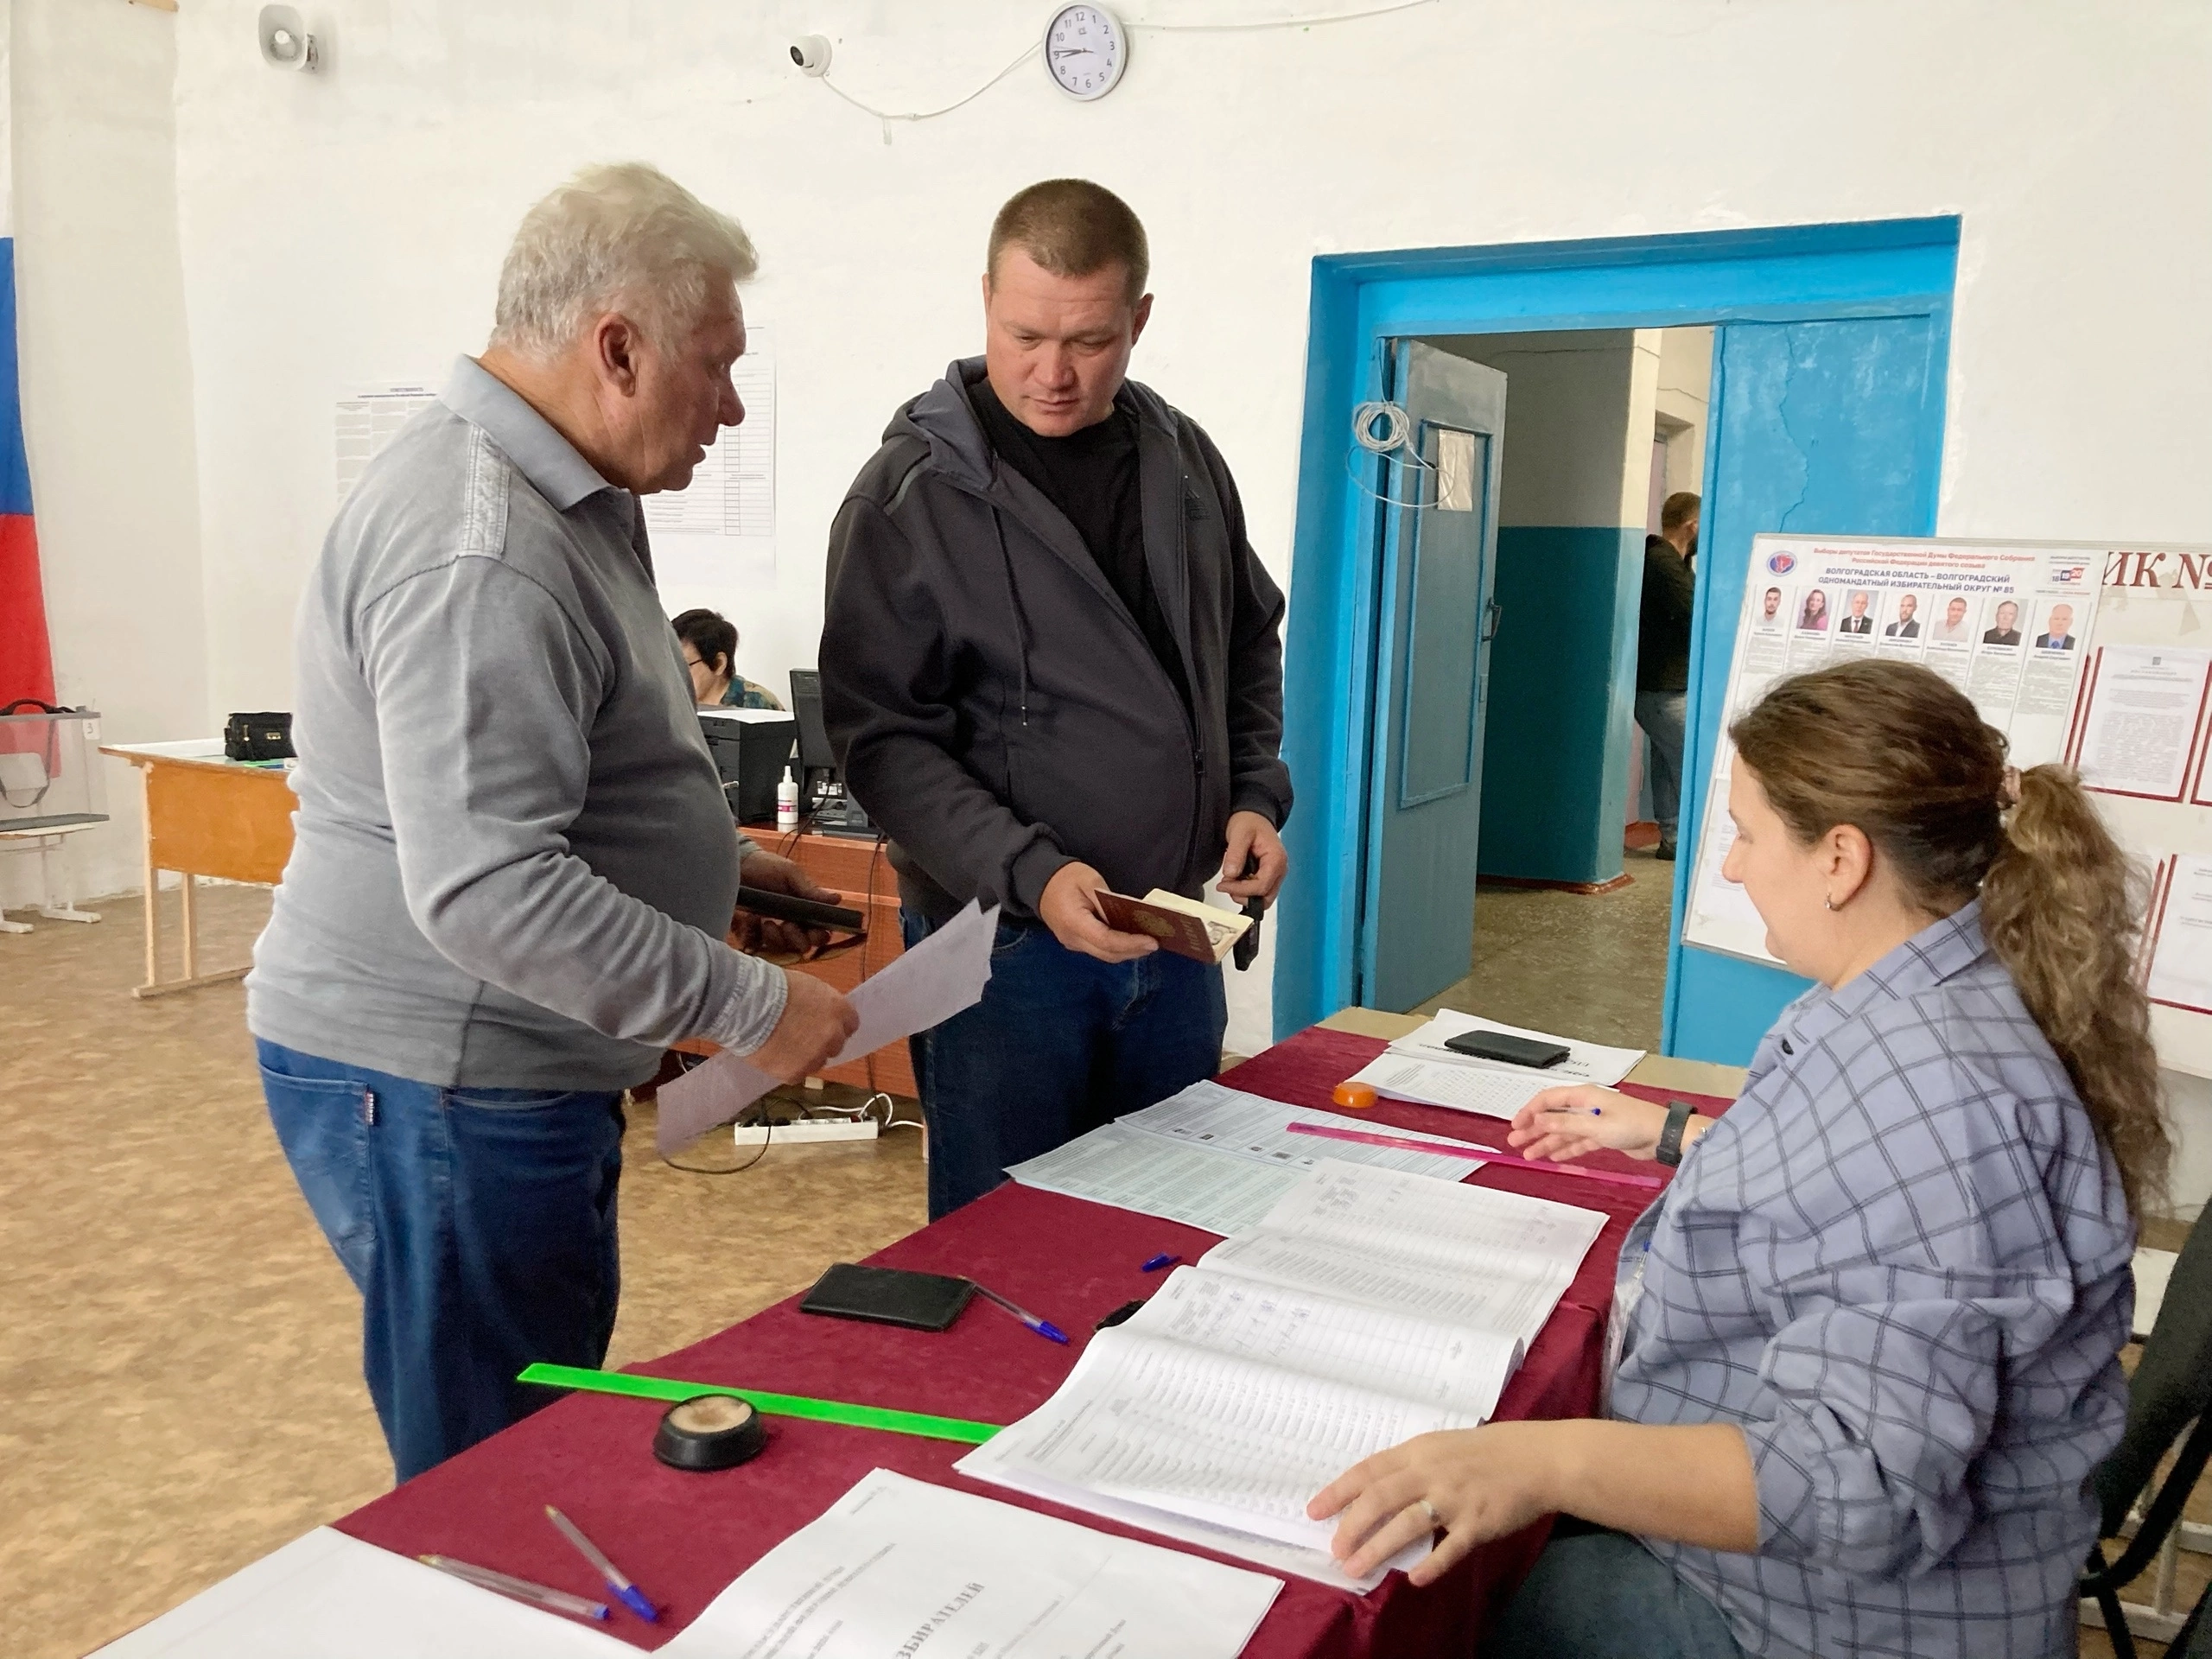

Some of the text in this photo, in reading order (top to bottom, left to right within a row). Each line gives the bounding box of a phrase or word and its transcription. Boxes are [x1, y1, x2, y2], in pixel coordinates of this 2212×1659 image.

[1076, 12, 1085, 22] 12
[1092, 15, 1096, 23] 1
[1065, 19, 1072, 29] 11
[1103, 25, 1109, 35] 2
[1056, 32, 1065, 42] 10
[1109, 41, 1115, 50] 3
[1053, 50, 1059, 60] 9
[1107, 59, 1112, 67] 4
[1060, 66, 1065, 75] 8
[1072, 77, 1077, 86] 7
[1099, 73, 1104, 82] 5
[1085, 79, 1091, 88] 6
[1872, 550, 1927, 559] Государственной
[1826, 568, 1891, 578] ВОЛГОГРАДСКАЯ
[1936, 573, 2010, 583] ВОЛГОГРАДСКИЙ
[1818, 577, 1889, 587] ОДНОМАНДАТНЫЙ
[1890, 580, 1961, 591] ИЗБИРАТЕЛЬНЫЙ
[1963, 582, 1992, 593] ОКРУГ
